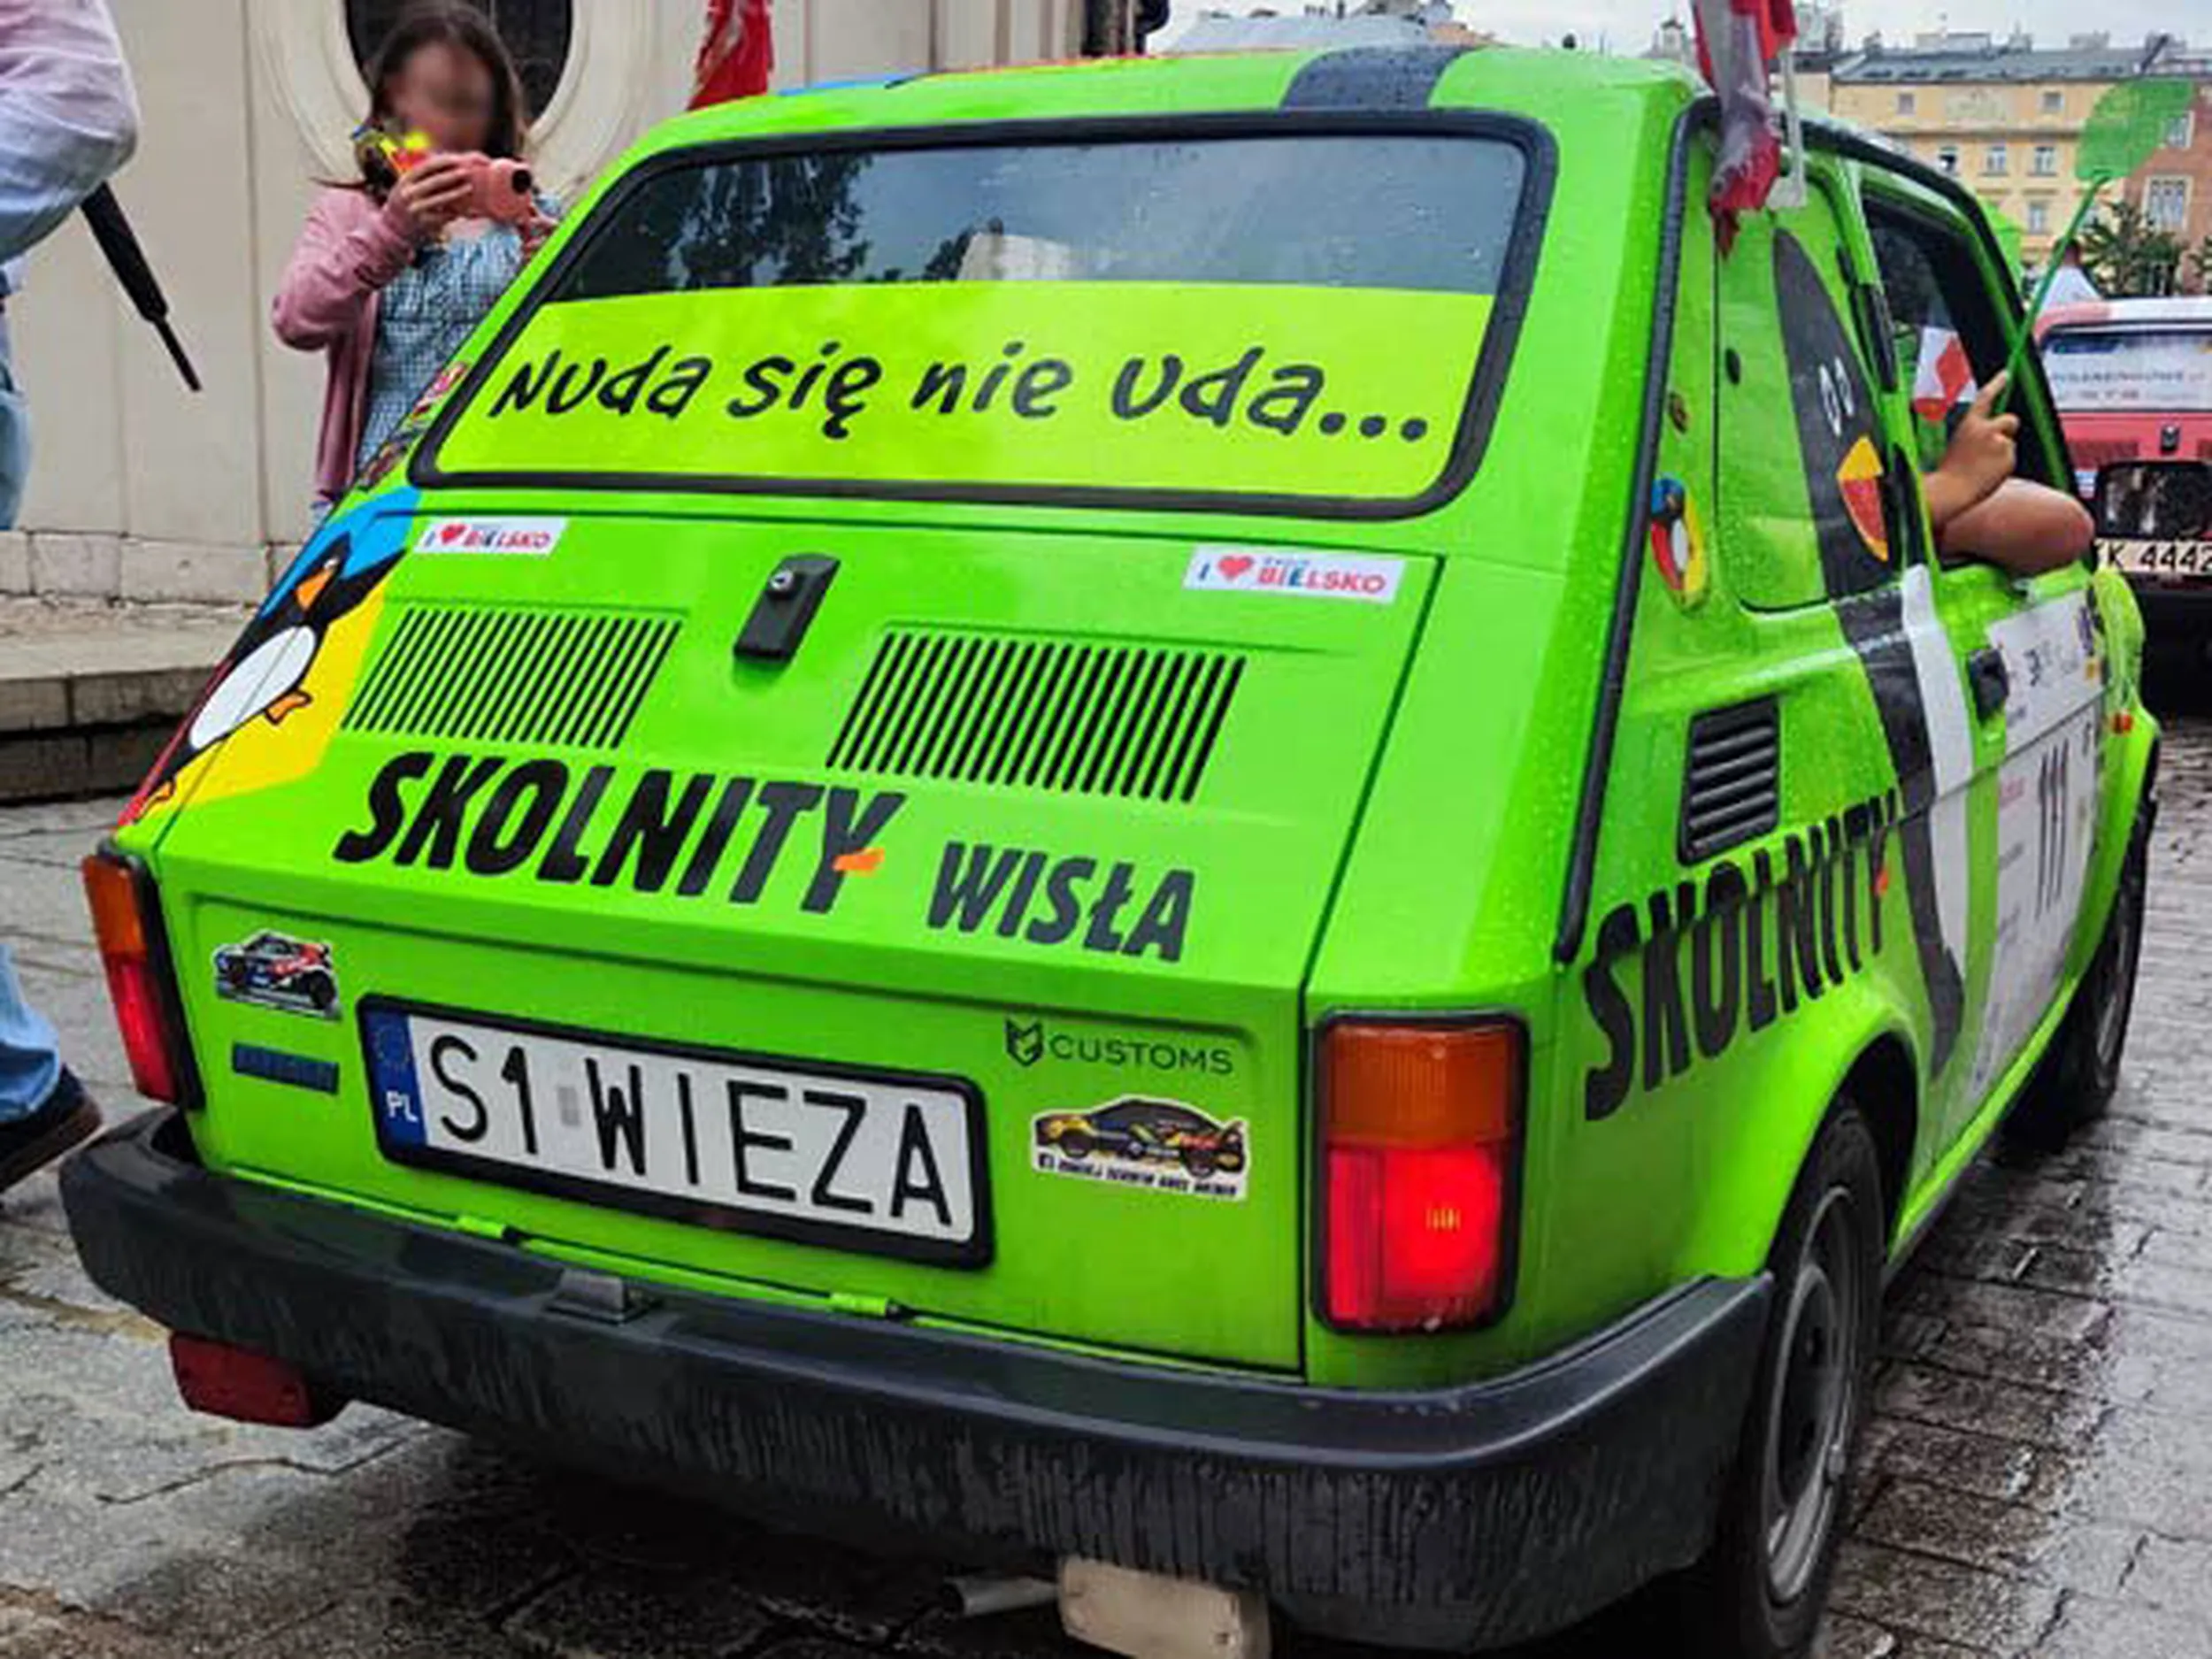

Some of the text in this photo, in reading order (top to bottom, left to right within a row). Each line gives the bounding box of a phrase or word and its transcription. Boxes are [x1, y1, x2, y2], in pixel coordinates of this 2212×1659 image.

[726, 341, 883, 440] się
[909, 341, 1074, 420] nie
[1256, 565, 1386, 595] BIELSKO
[2094, 539, 2125, 567] K
[332, 750, 1195, 964] SKOLNITY WISŁA
[1584, 787, 1896, 1122] SKOLNITY
[1048, 1033, 1234, 1075] CUSTOMS
[385, 1089, 419, 1123] PL
[428, 1033, 953, 1227] S1 WIEZA
